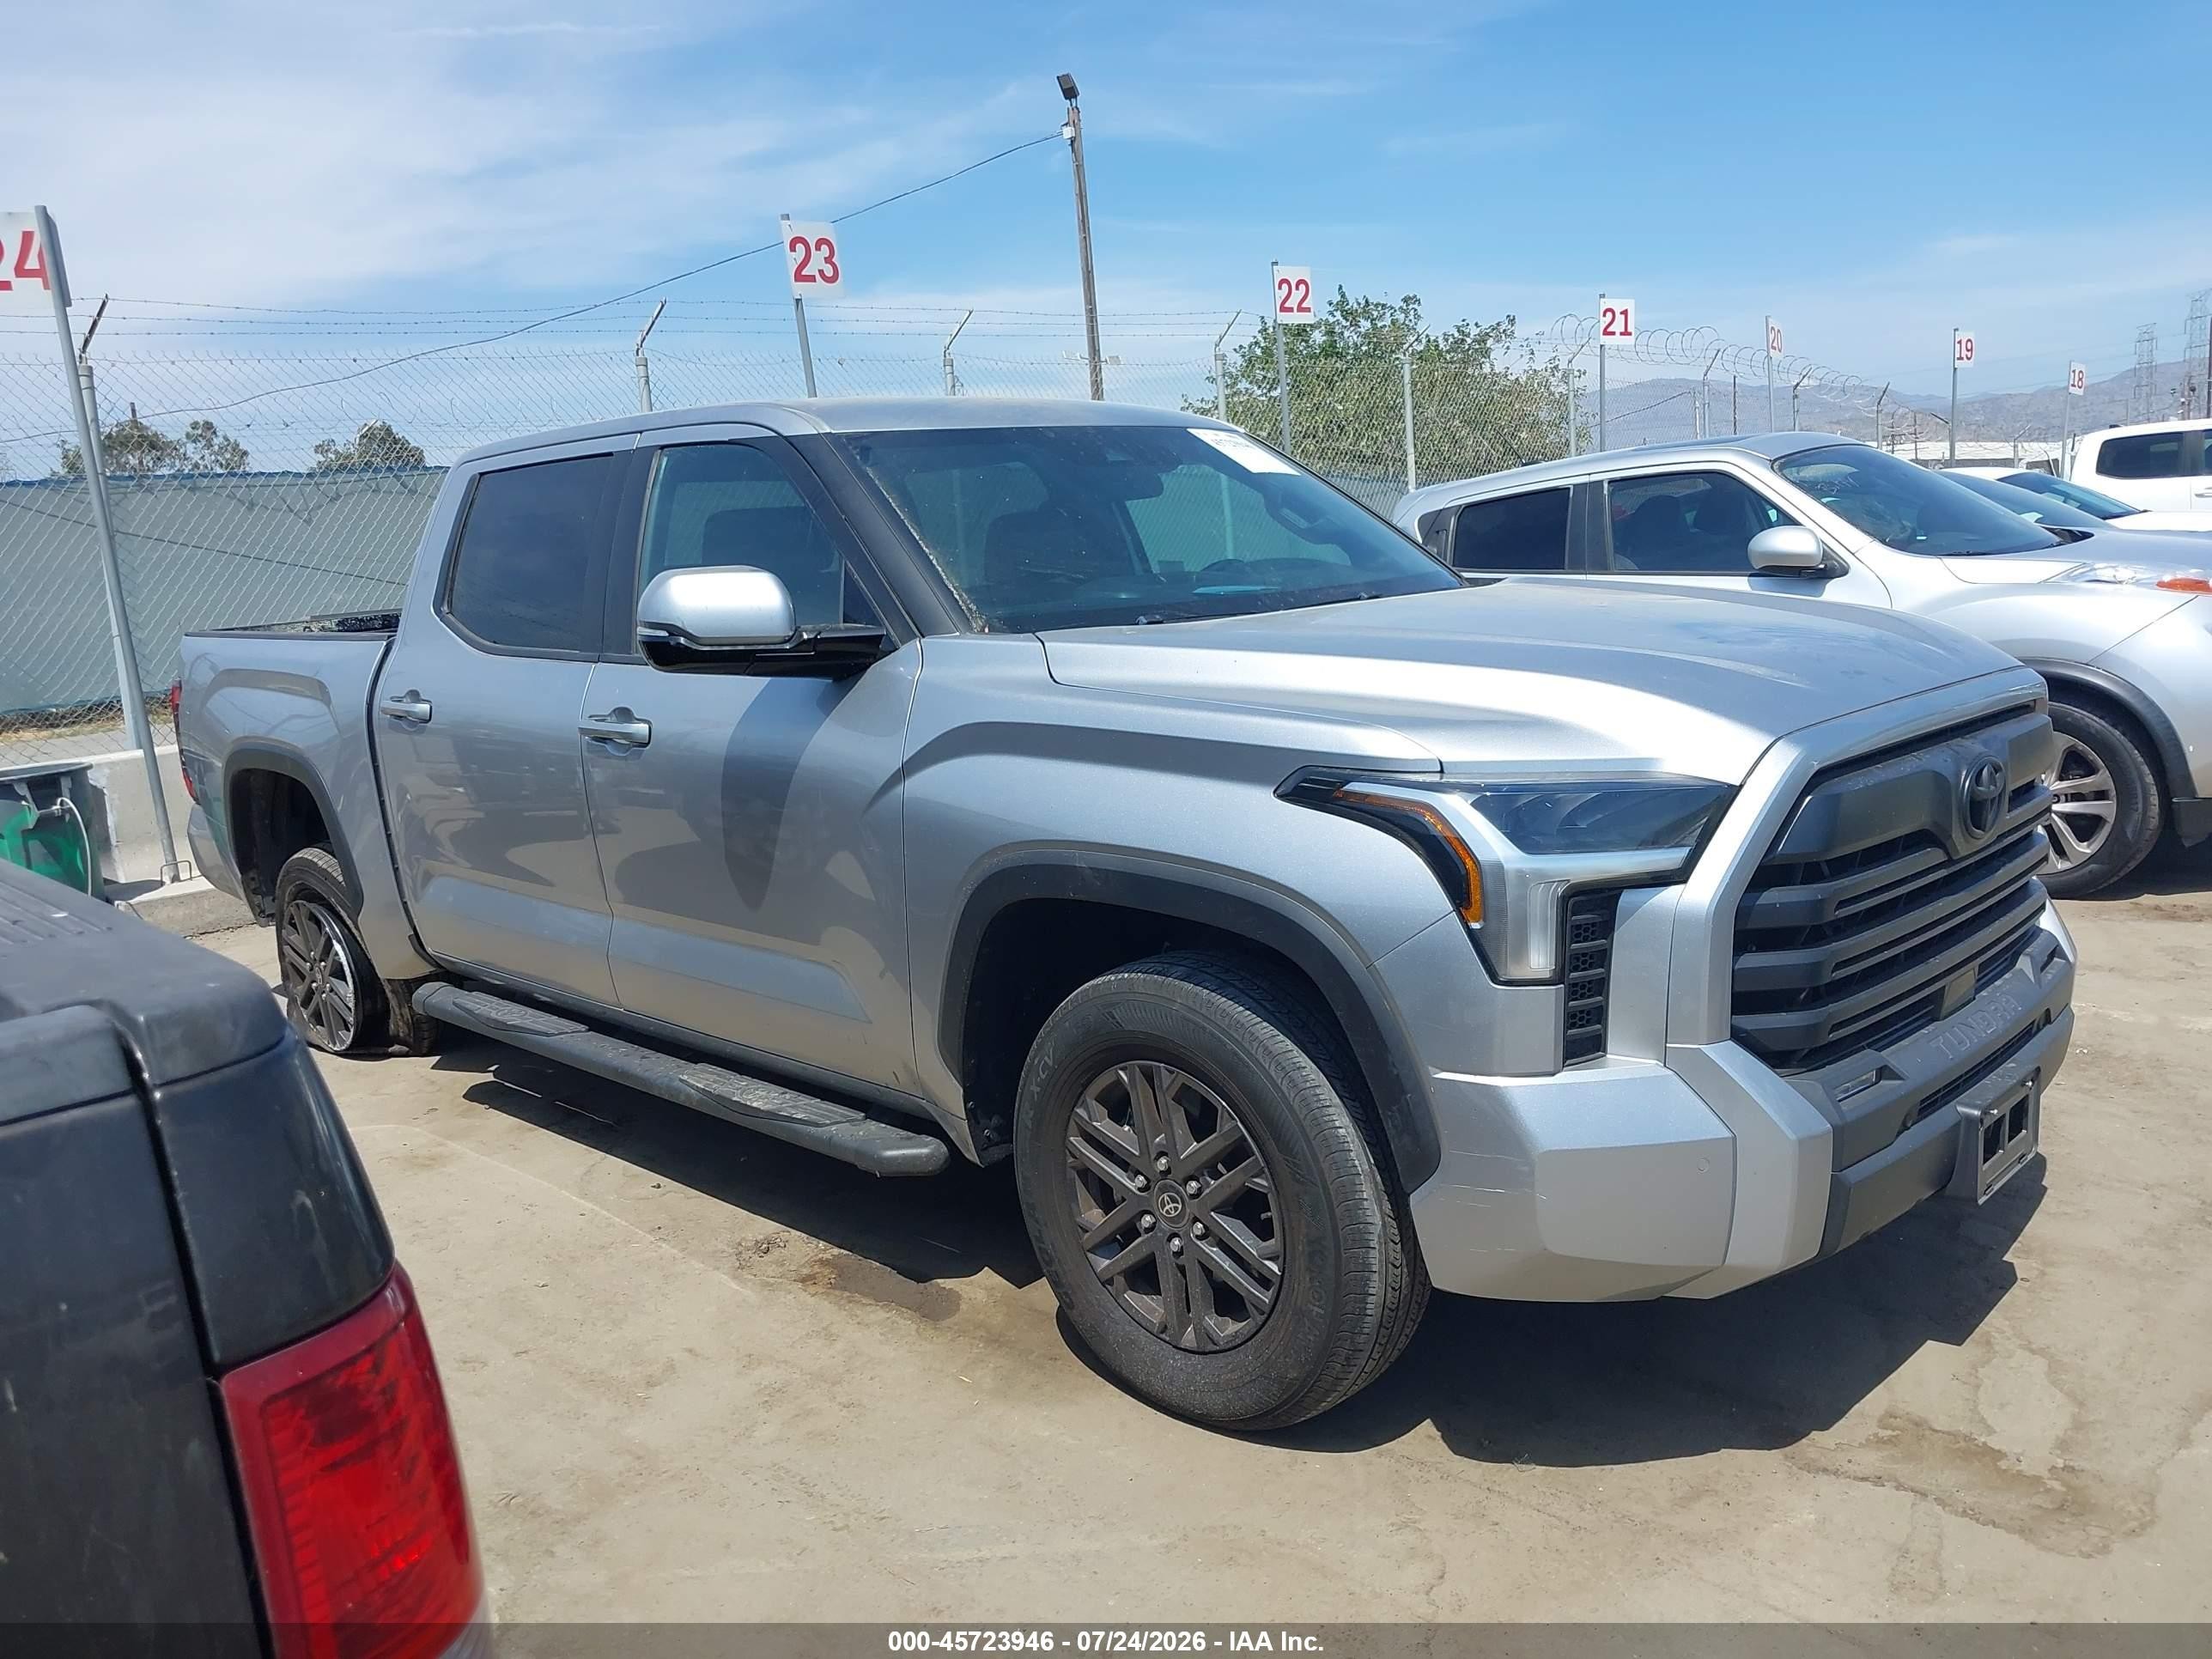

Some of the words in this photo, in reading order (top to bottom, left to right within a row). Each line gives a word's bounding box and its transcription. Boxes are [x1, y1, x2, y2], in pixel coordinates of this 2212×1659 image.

[788, 236, 839, 284] 23
[1278, 277, 1311, 313] 22
[1601, 307, 1632, 337] 21
[1770, 325, 1783, 353] 20
[1956, 338, 1973, 361] 19
[2070, 368, 2084, 389] 18
[1930, 994, 2022, 1059] TUNDRA
